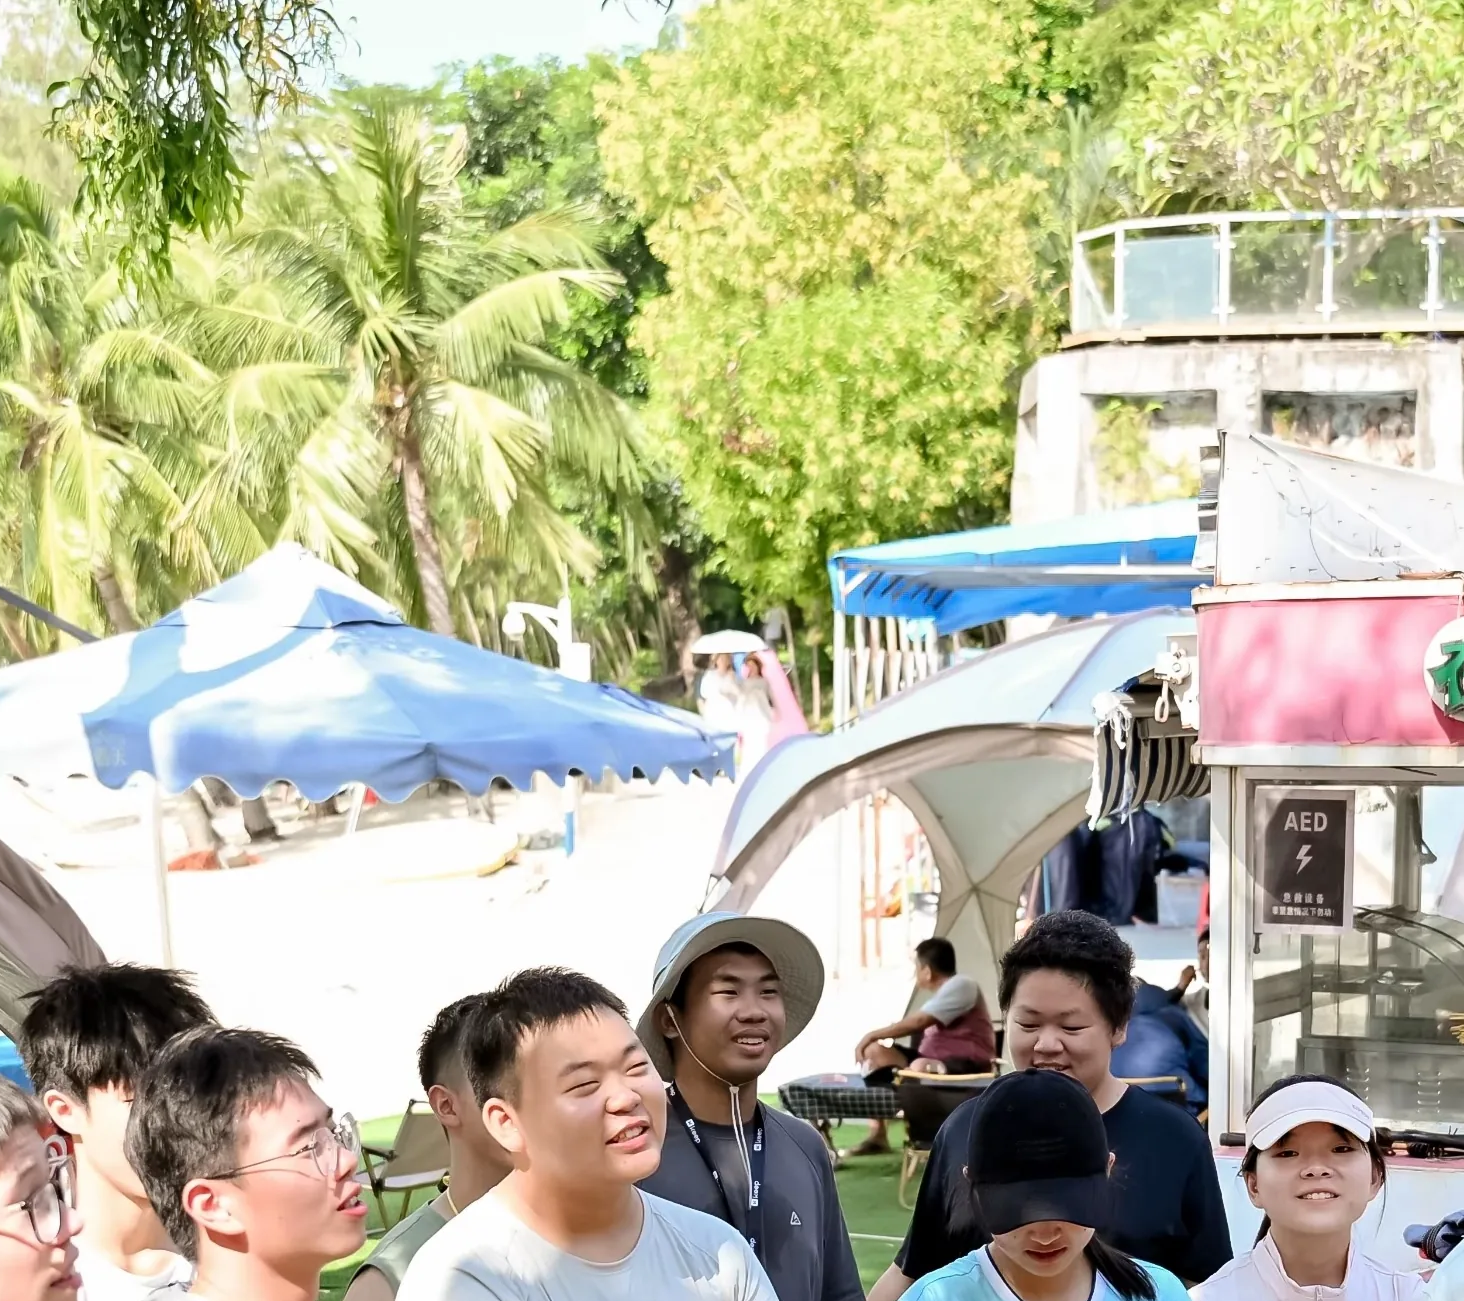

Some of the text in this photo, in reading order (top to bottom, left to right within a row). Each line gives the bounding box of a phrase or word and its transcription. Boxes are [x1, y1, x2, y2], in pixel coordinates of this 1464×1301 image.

[1284, 812, 1328, 832] AED
[1282, 892, 1324, 904] 急救设备
[689, 1125, 701, 1144] keep
[755, 1128, 763, 1144] keep
[753, 1181, 761, 1198] keep
